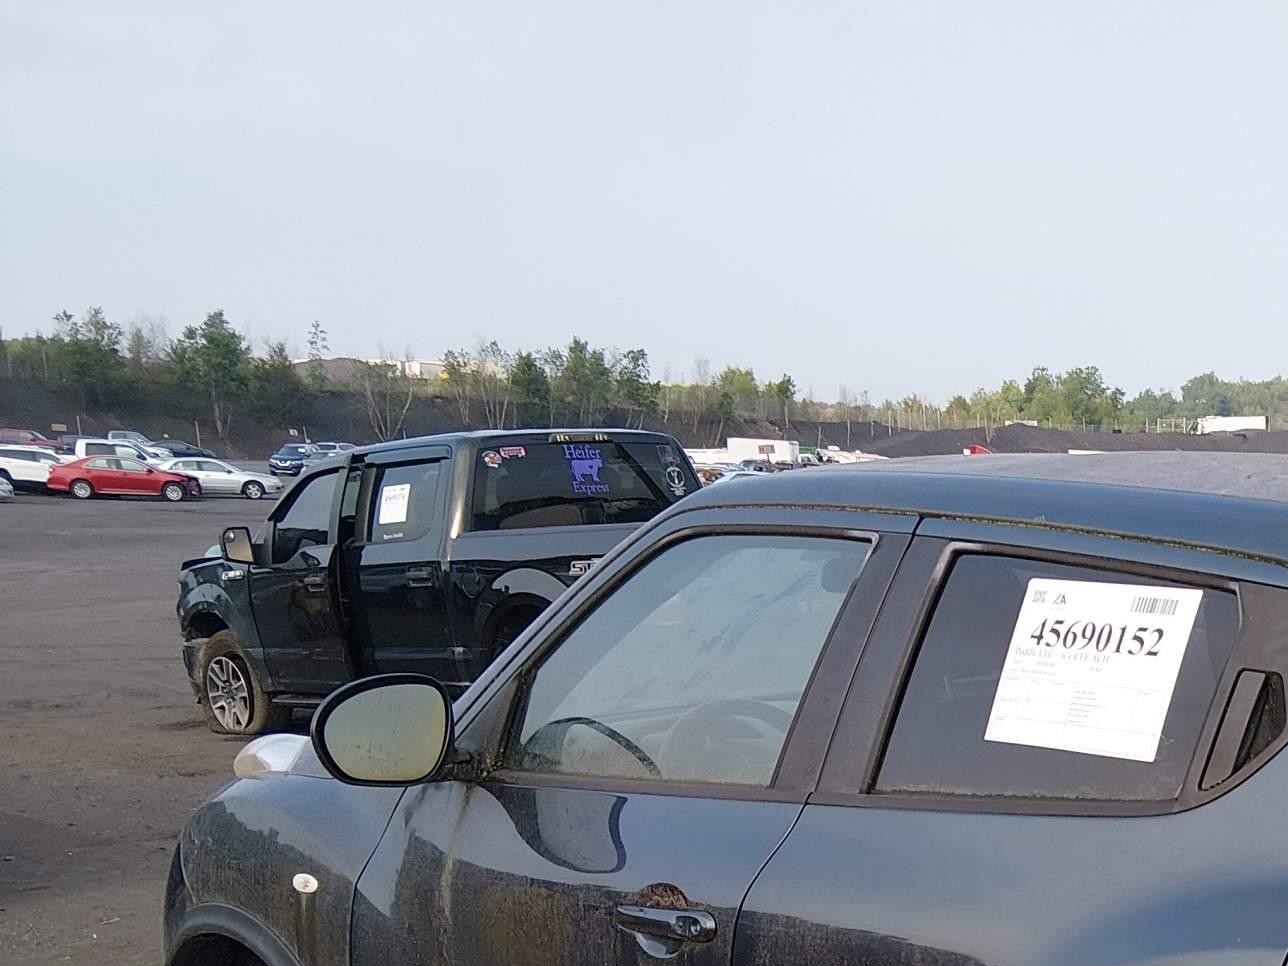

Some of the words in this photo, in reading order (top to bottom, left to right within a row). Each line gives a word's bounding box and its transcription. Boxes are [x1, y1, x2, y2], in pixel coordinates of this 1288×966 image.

[563, 444, 601, 458] Heifer
[573, 481, 610, 495] Express
[1029, 617, 1165, 658] 45690152
